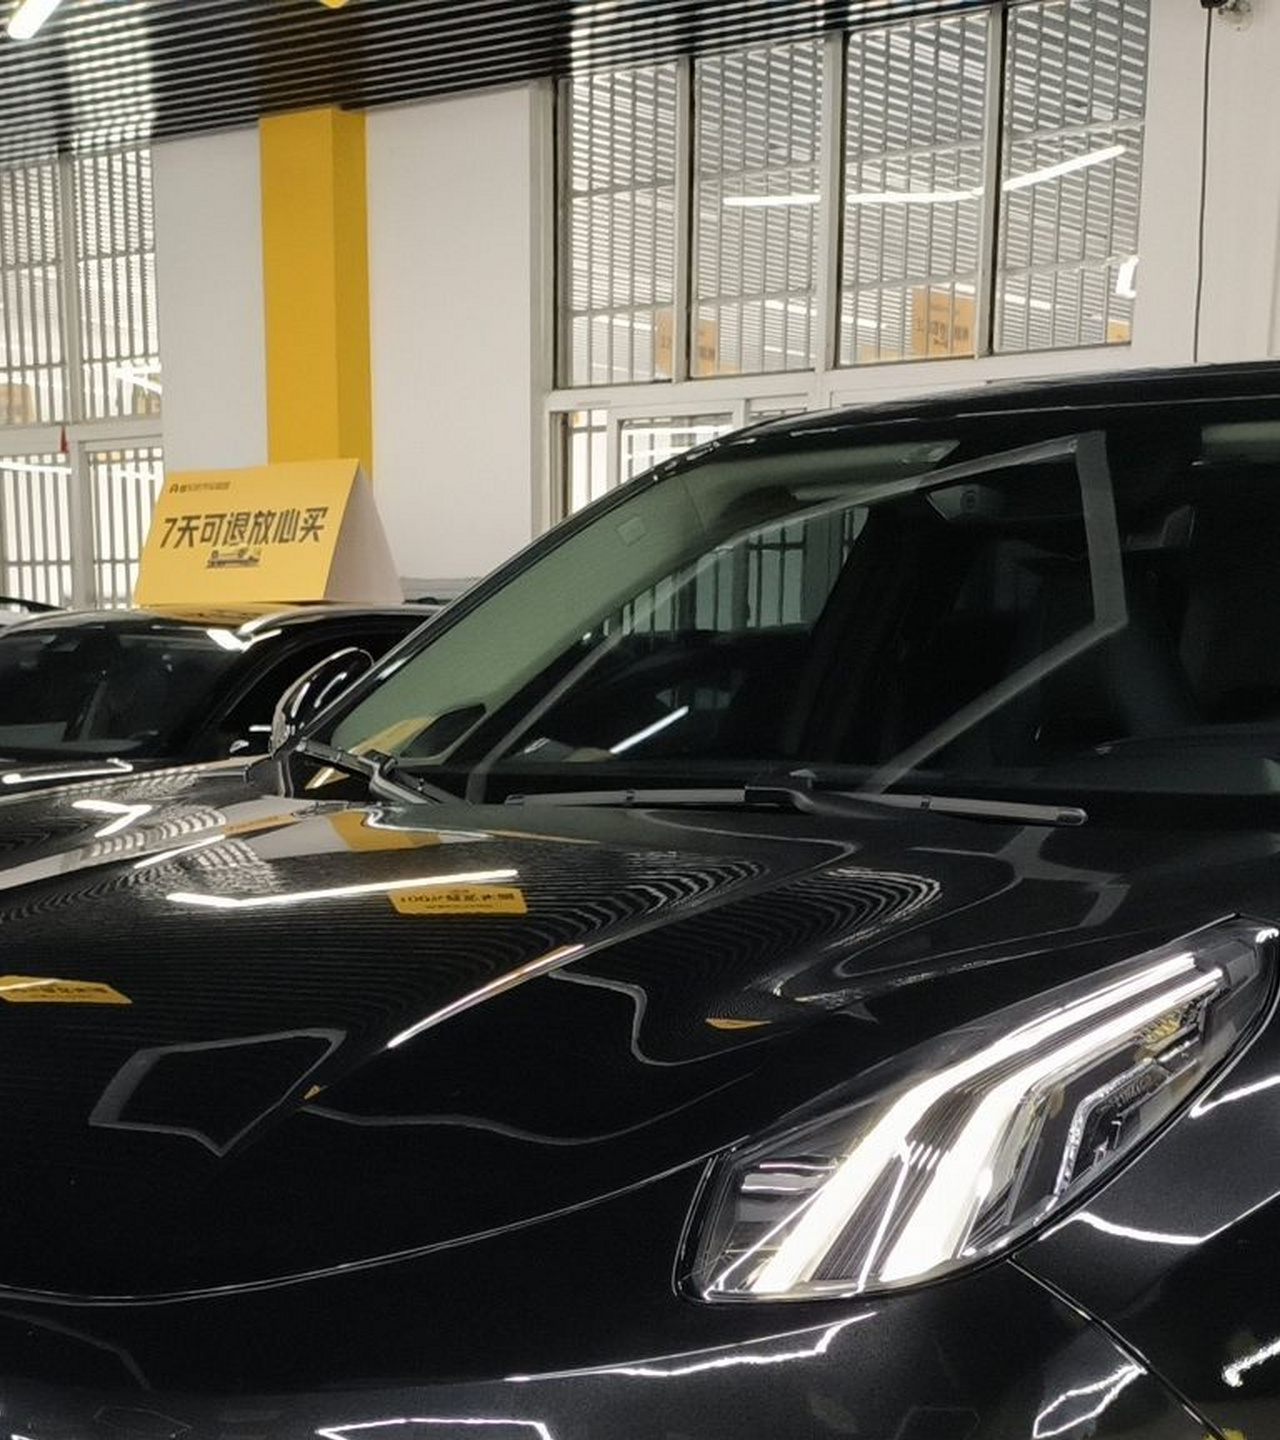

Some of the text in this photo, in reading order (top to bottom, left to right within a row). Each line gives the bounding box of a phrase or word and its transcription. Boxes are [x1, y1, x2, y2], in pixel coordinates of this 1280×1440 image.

[160, 506, 329, 548] 7天可退放心买
